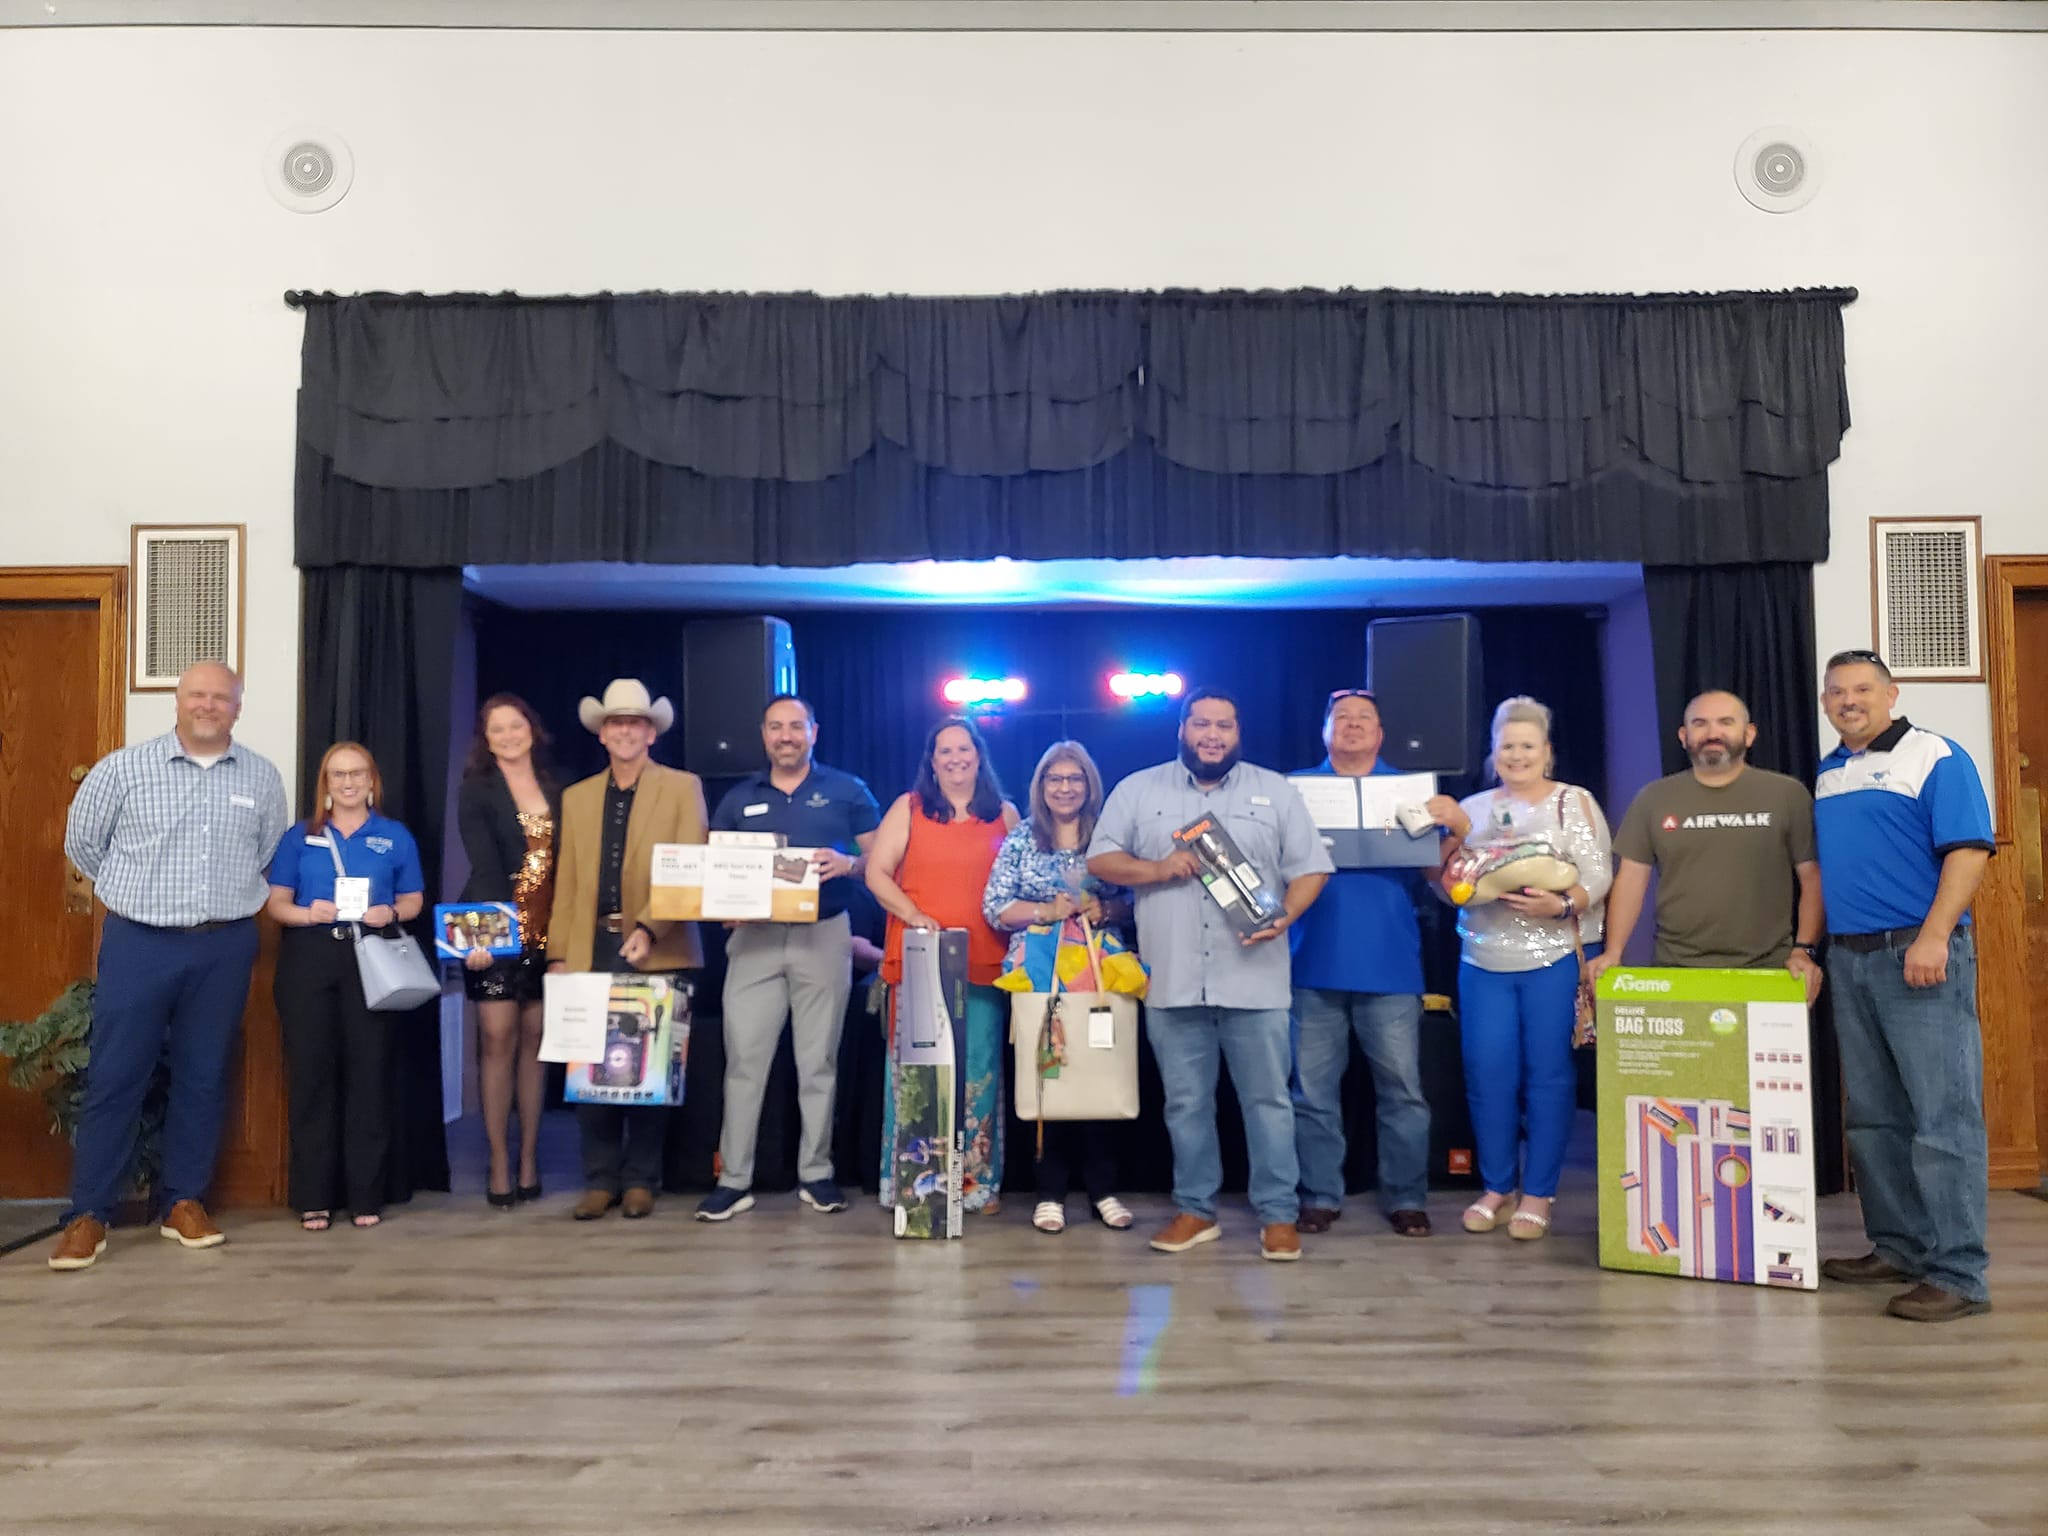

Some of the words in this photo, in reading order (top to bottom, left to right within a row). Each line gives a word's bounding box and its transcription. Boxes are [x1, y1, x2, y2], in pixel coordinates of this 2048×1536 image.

[1682, 812, 1772, 829] AIRWALK
[1615, 1016, 1644, 1035] BAG
[1647, 1017, 1685, 1037] TOSS
